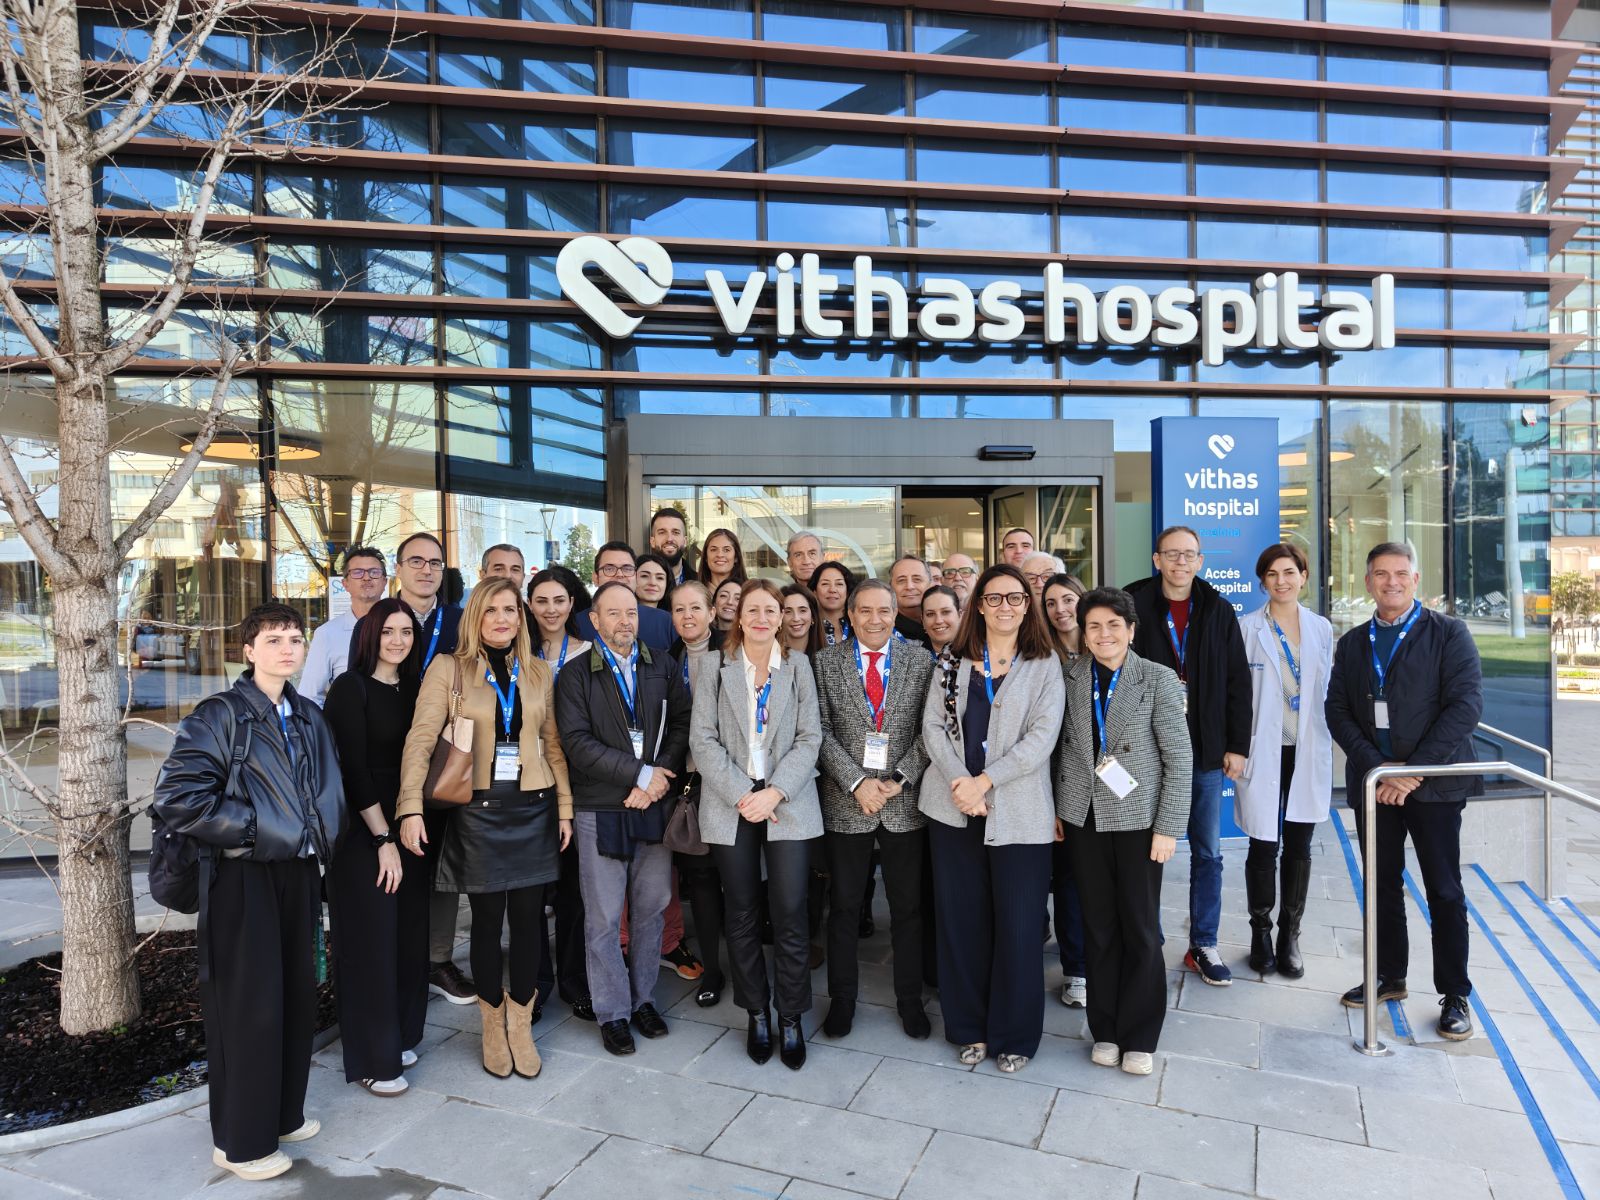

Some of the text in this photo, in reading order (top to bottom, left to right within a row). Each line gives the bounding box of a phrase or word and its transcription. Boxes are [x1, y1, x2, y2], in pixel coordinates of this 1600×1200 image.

[705, 252, 1395, 366] vithas hospital
[1185, 468, 1259, 490] vithas
[1184, 498, 1259, 519] hospital
[1205, 568, 1240, 579] Accés
[1209, 582, 1252, 595] ospital
